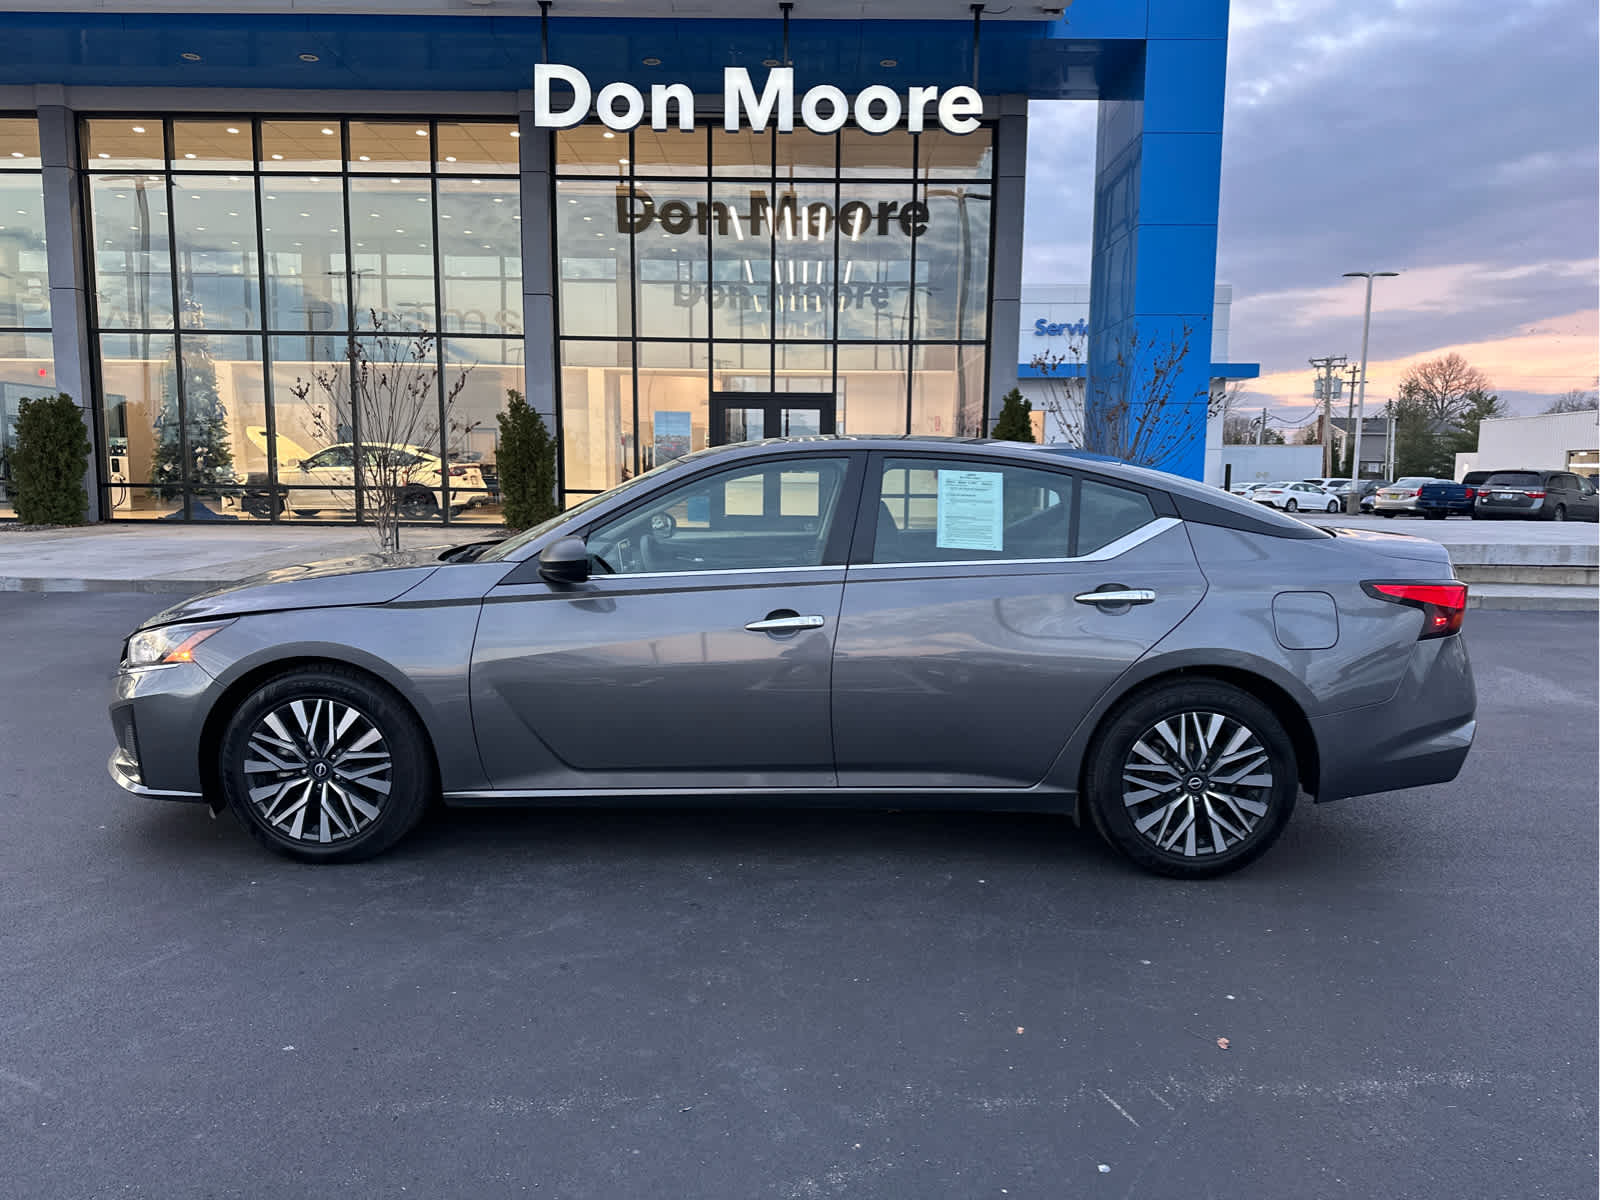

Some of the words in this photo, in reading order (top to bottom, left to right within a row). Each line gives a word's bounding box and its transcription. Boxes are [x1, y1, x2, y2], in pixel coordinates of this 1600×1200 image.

[534, 64, 695, 131] Don
[724, 67, 983, 135] Moore
[616, 186, 729, 235] Don
[750, 190, 930, 237] Moore
